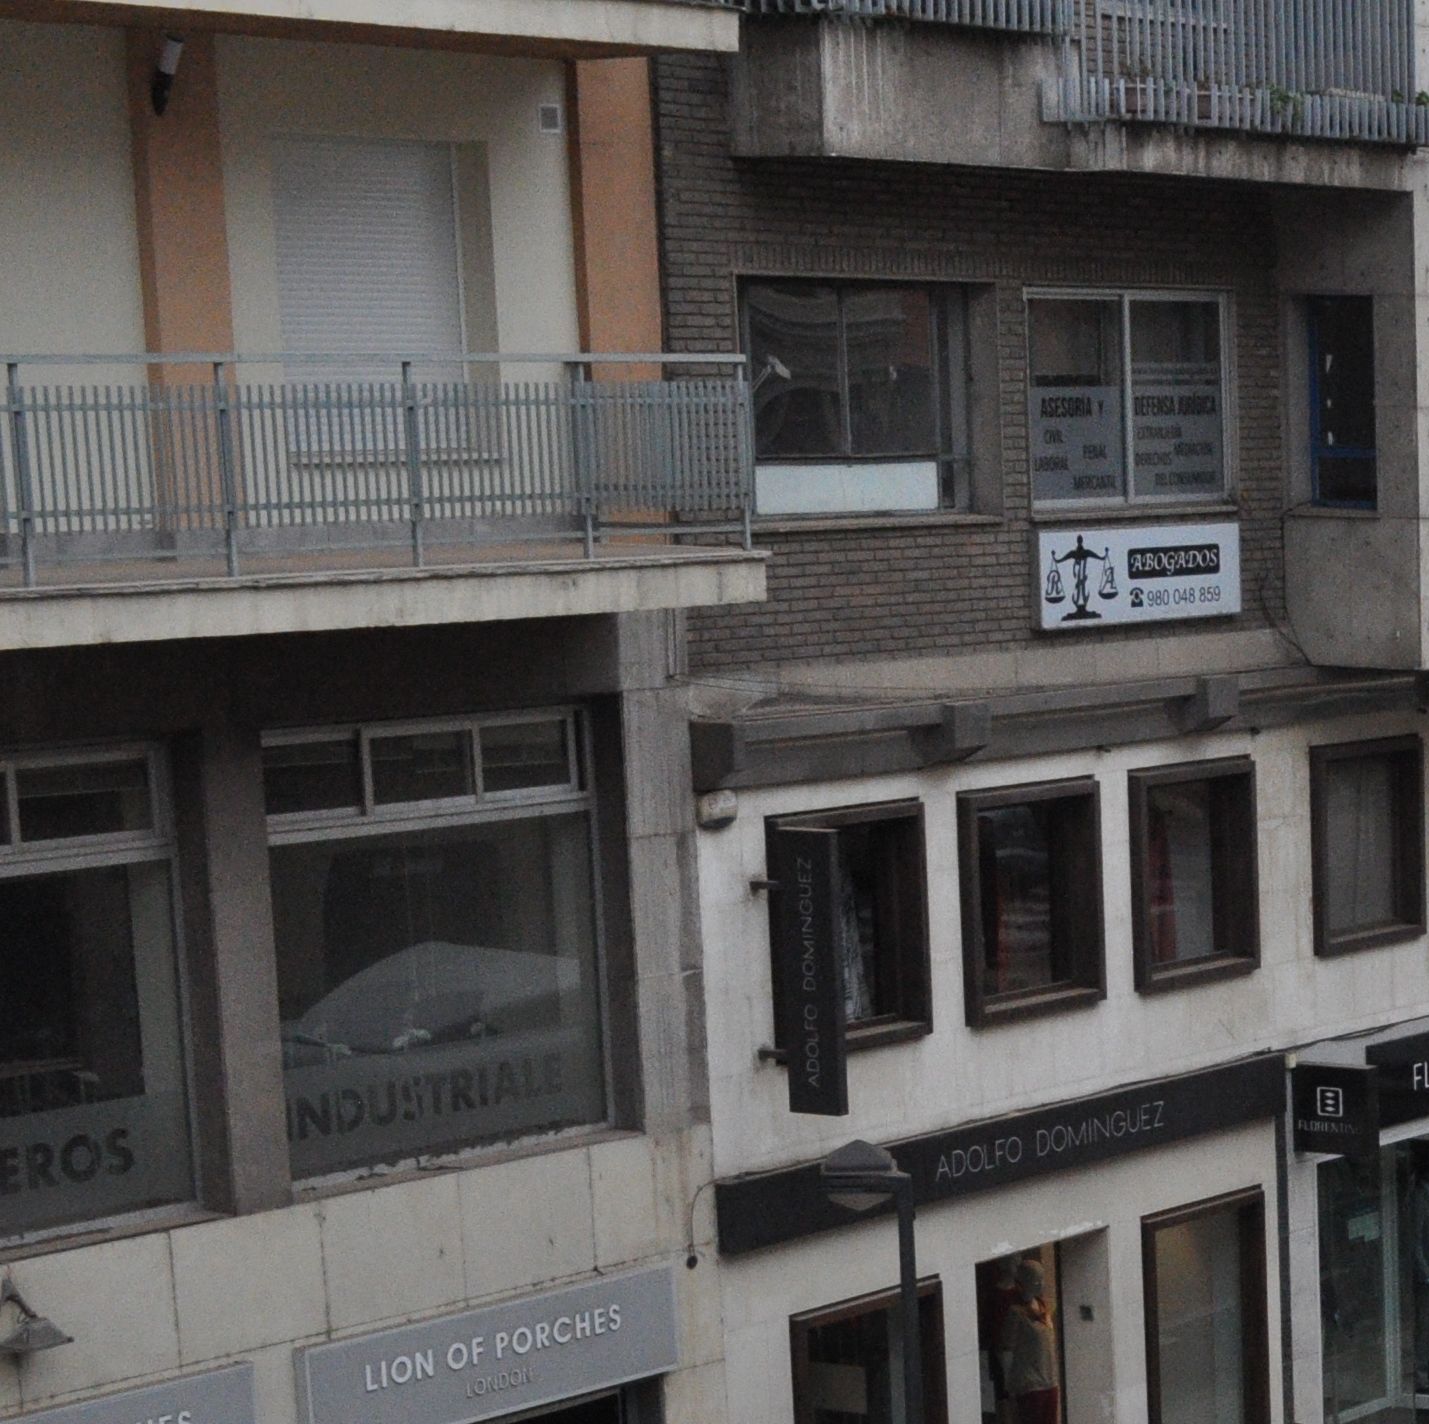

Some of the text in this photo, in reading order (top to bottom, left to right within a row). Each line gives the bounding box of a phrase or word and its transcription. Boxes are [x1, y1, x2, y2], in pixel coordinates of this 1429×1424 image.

[1134, 396, 1175, 416] DEFENSA
[1131, 549, 1218, 575] ABOGADOS
[1147, 585, 1220, 607] 980 048 859
[797, 857, 817, 992] DOMINGUEZ
[804, 1003, 820, 1088] ADOLFO
[935, 1101, 1165, 1182] ADOLFO DOMINGUEZ
[365, 1304, 622, 1392] LION OF PORCHES
[466, 1368, 534, 1398] LONDON
